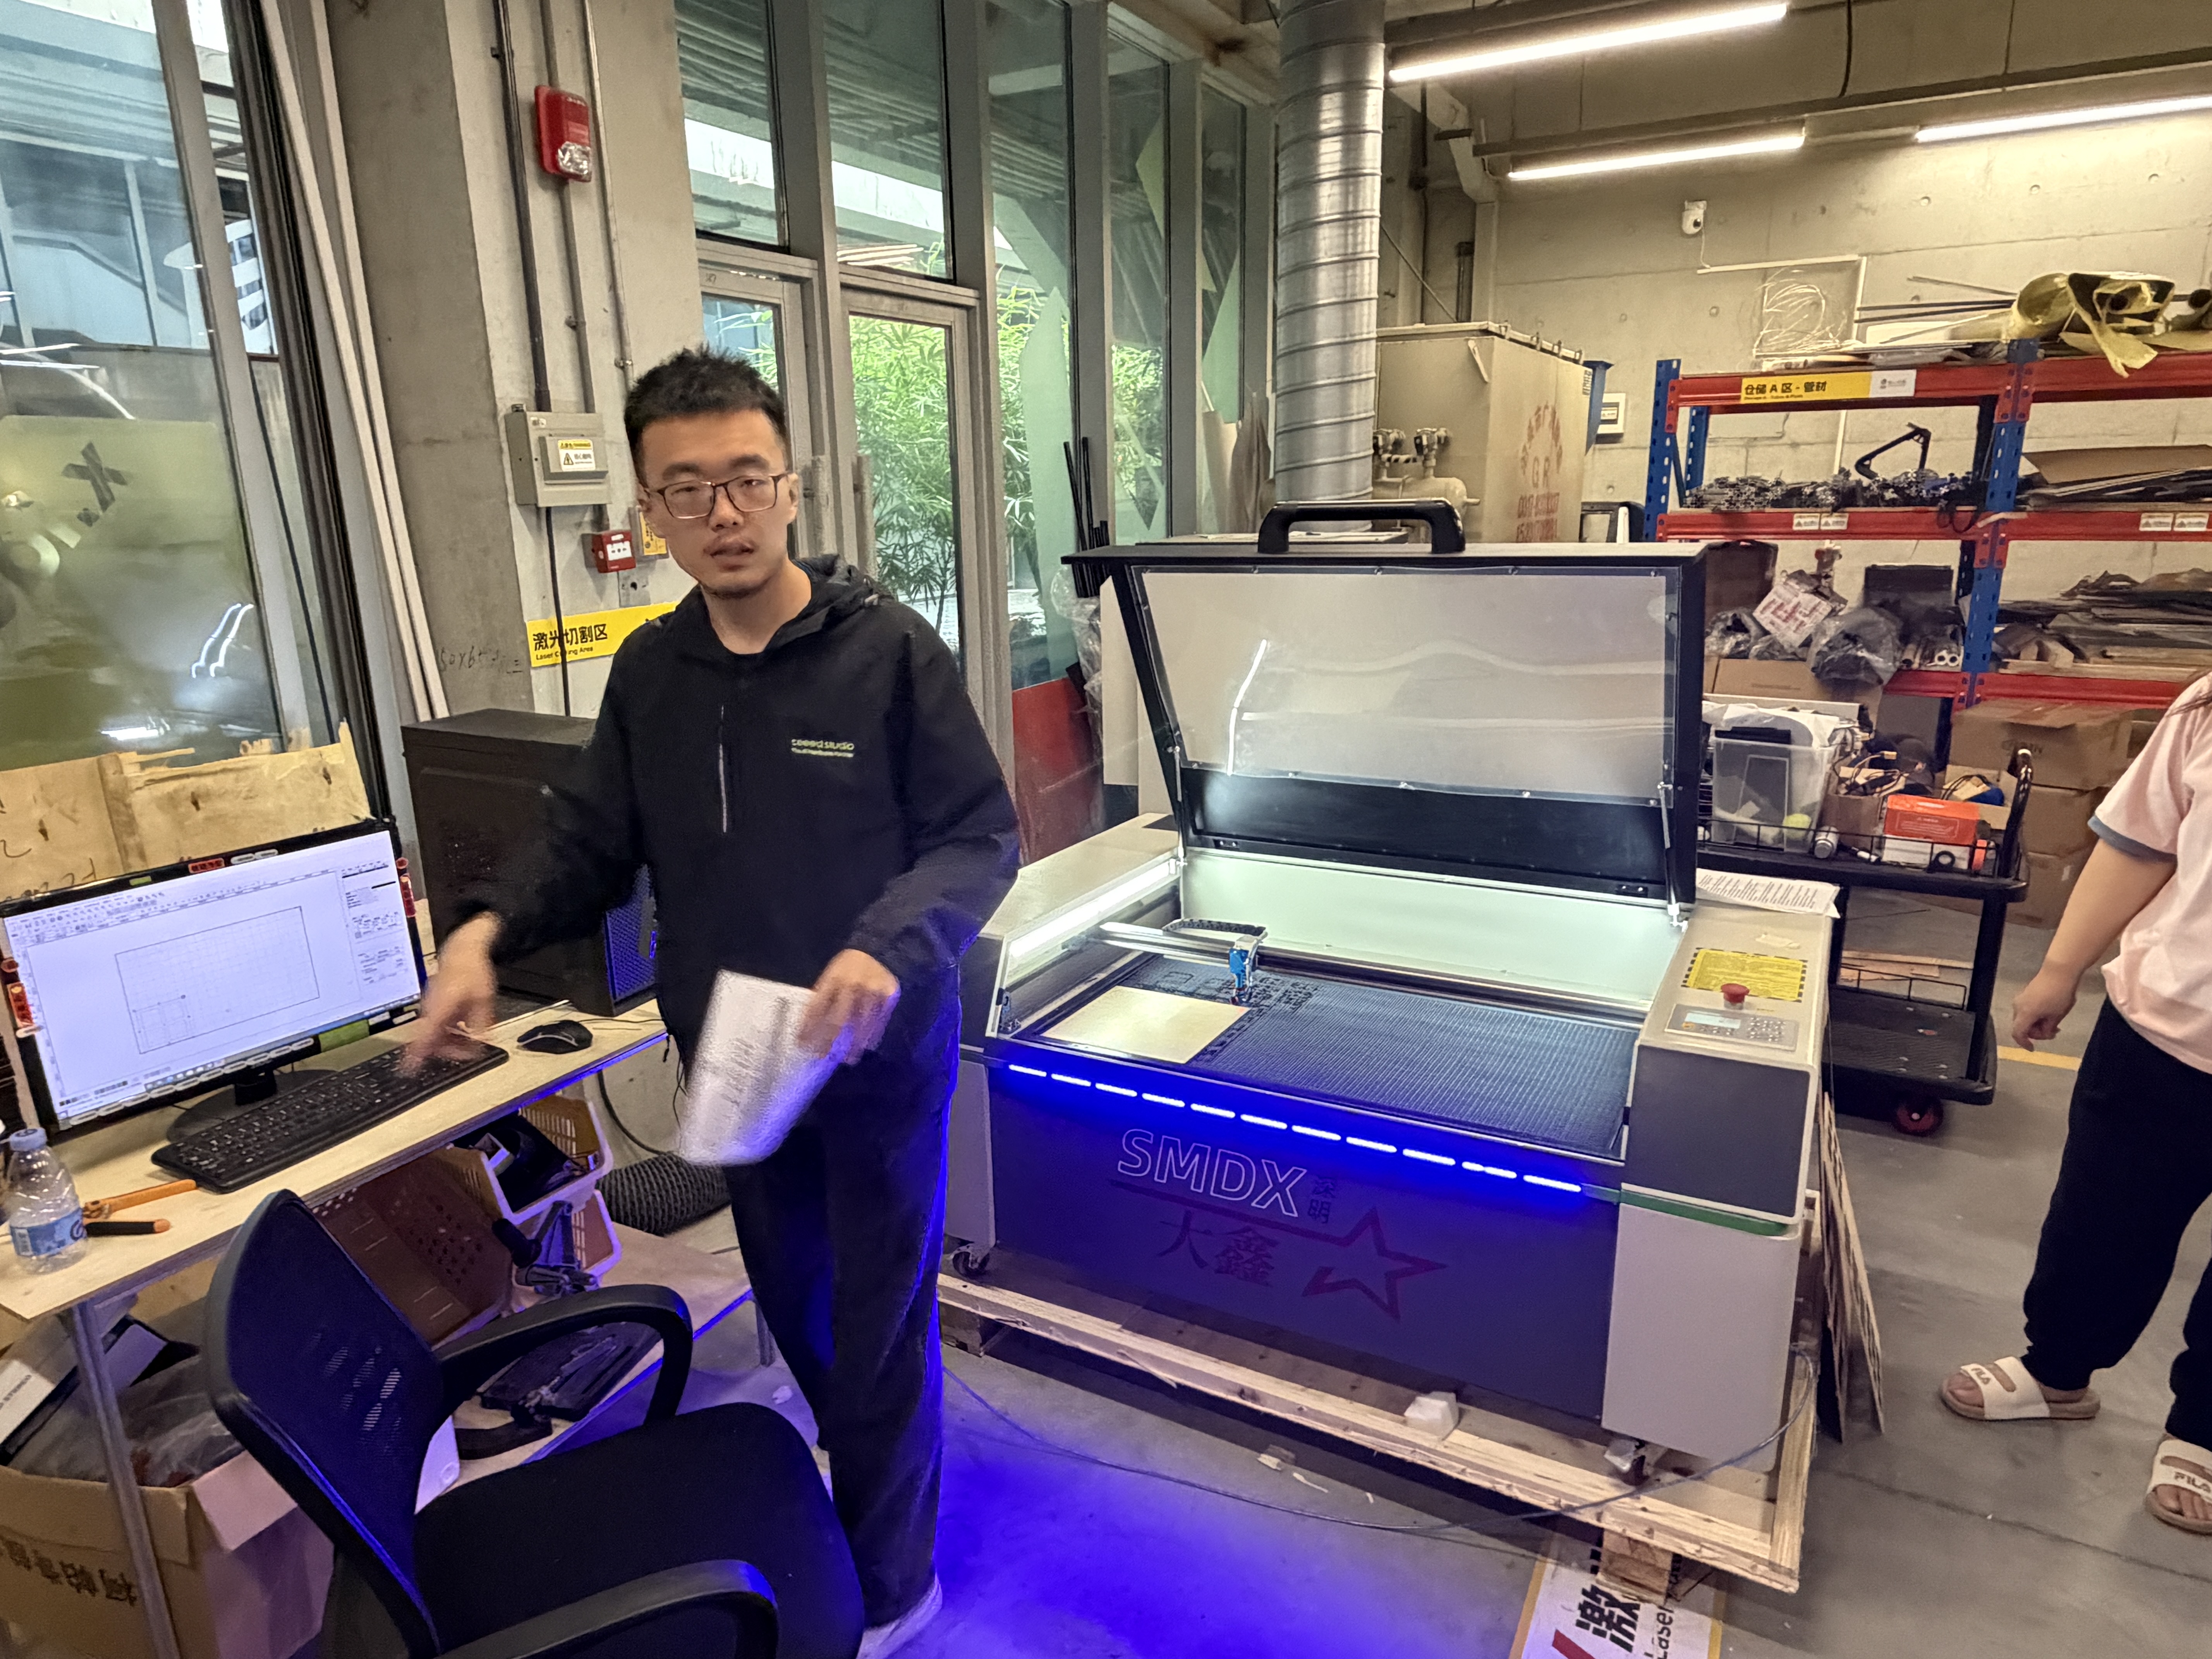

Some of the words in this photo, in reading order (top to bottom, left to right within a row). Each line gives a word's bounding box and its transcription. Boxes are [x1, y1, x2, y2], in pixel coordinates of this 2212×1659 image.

[1769, 384, 1778, 393] A
[1781, 383, 1792, 393] 区
[1118, 1128, 1307, 1217] SMDX
[1156, 1209, 1280, 1288] 大鑫
[1971, 1368, 1991, 1385] FILA
[2174, 1471, 2211, 1493] FILA
